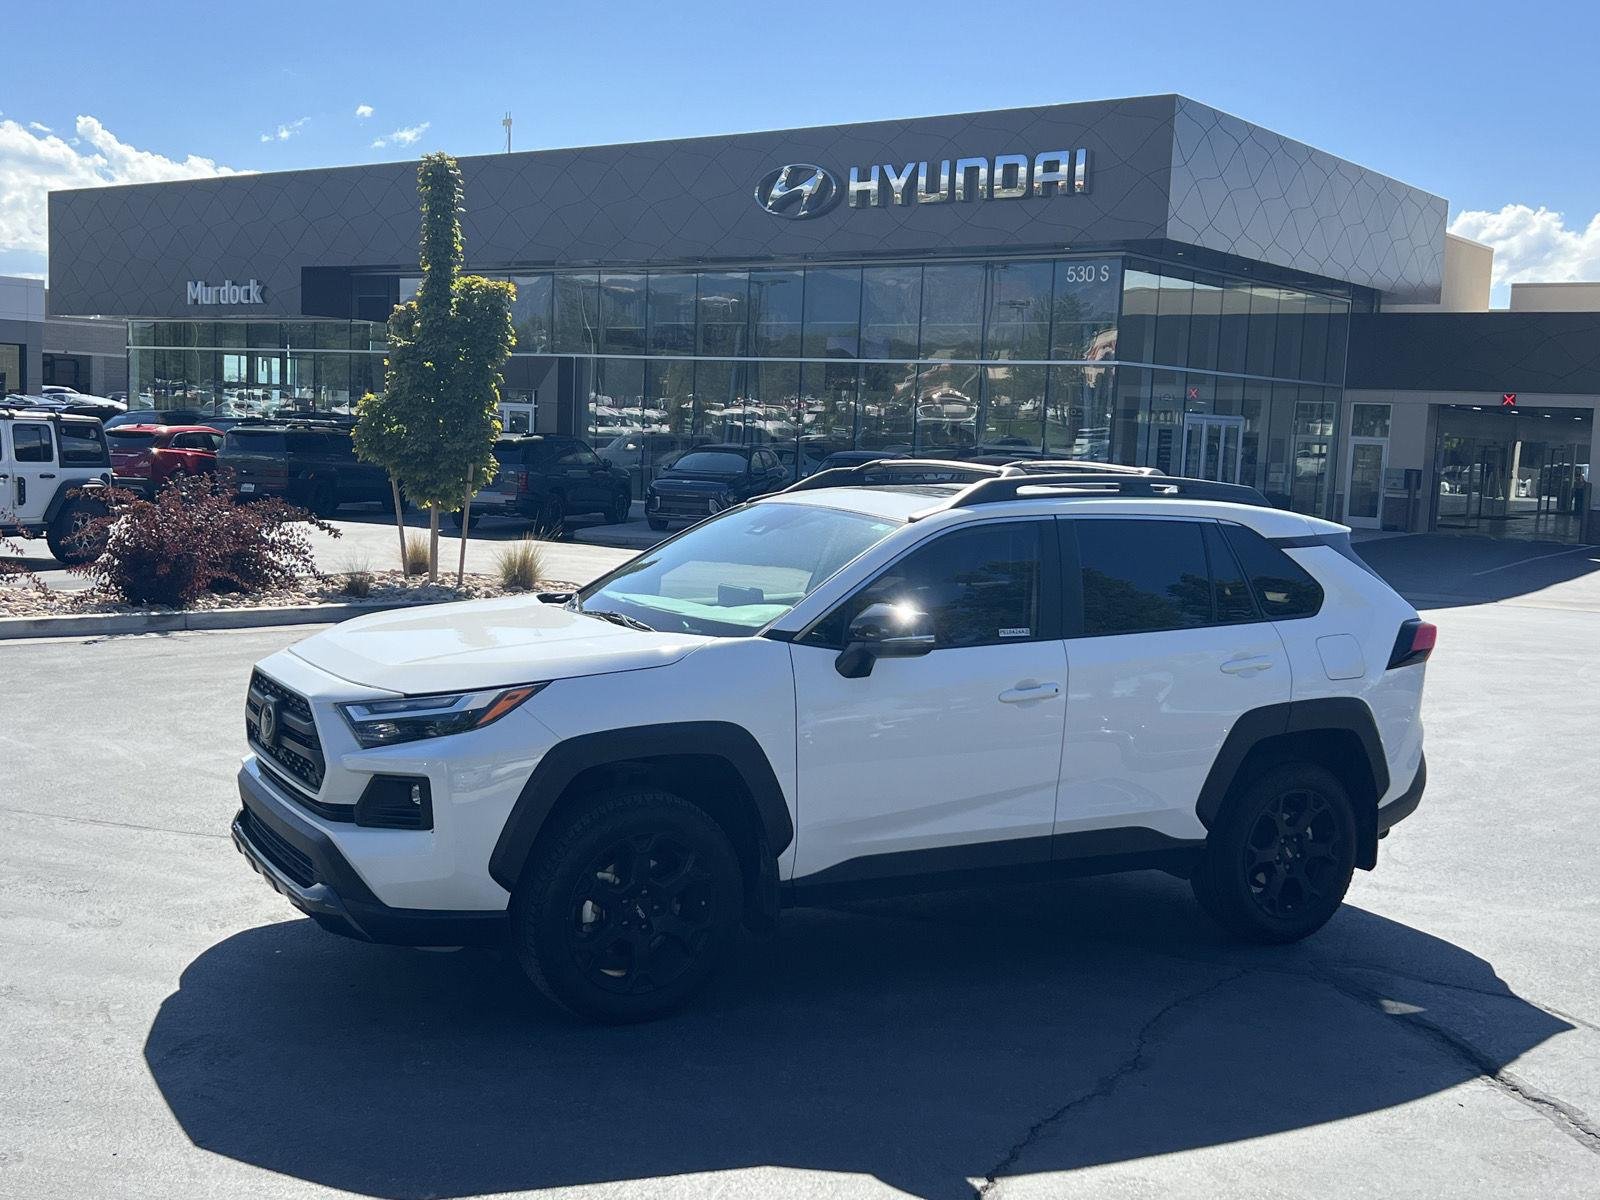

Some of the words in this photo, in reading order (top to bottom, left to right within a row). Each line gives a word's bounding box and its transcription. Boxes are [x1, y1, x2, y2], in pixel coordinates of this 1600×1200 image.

[849, 148, 1087, 208] HYUNDAI
[1066, 265, 1096, 283] 530
[1099, 264, 1110, 282] S
[186, 278, 265, 305] Murdock
